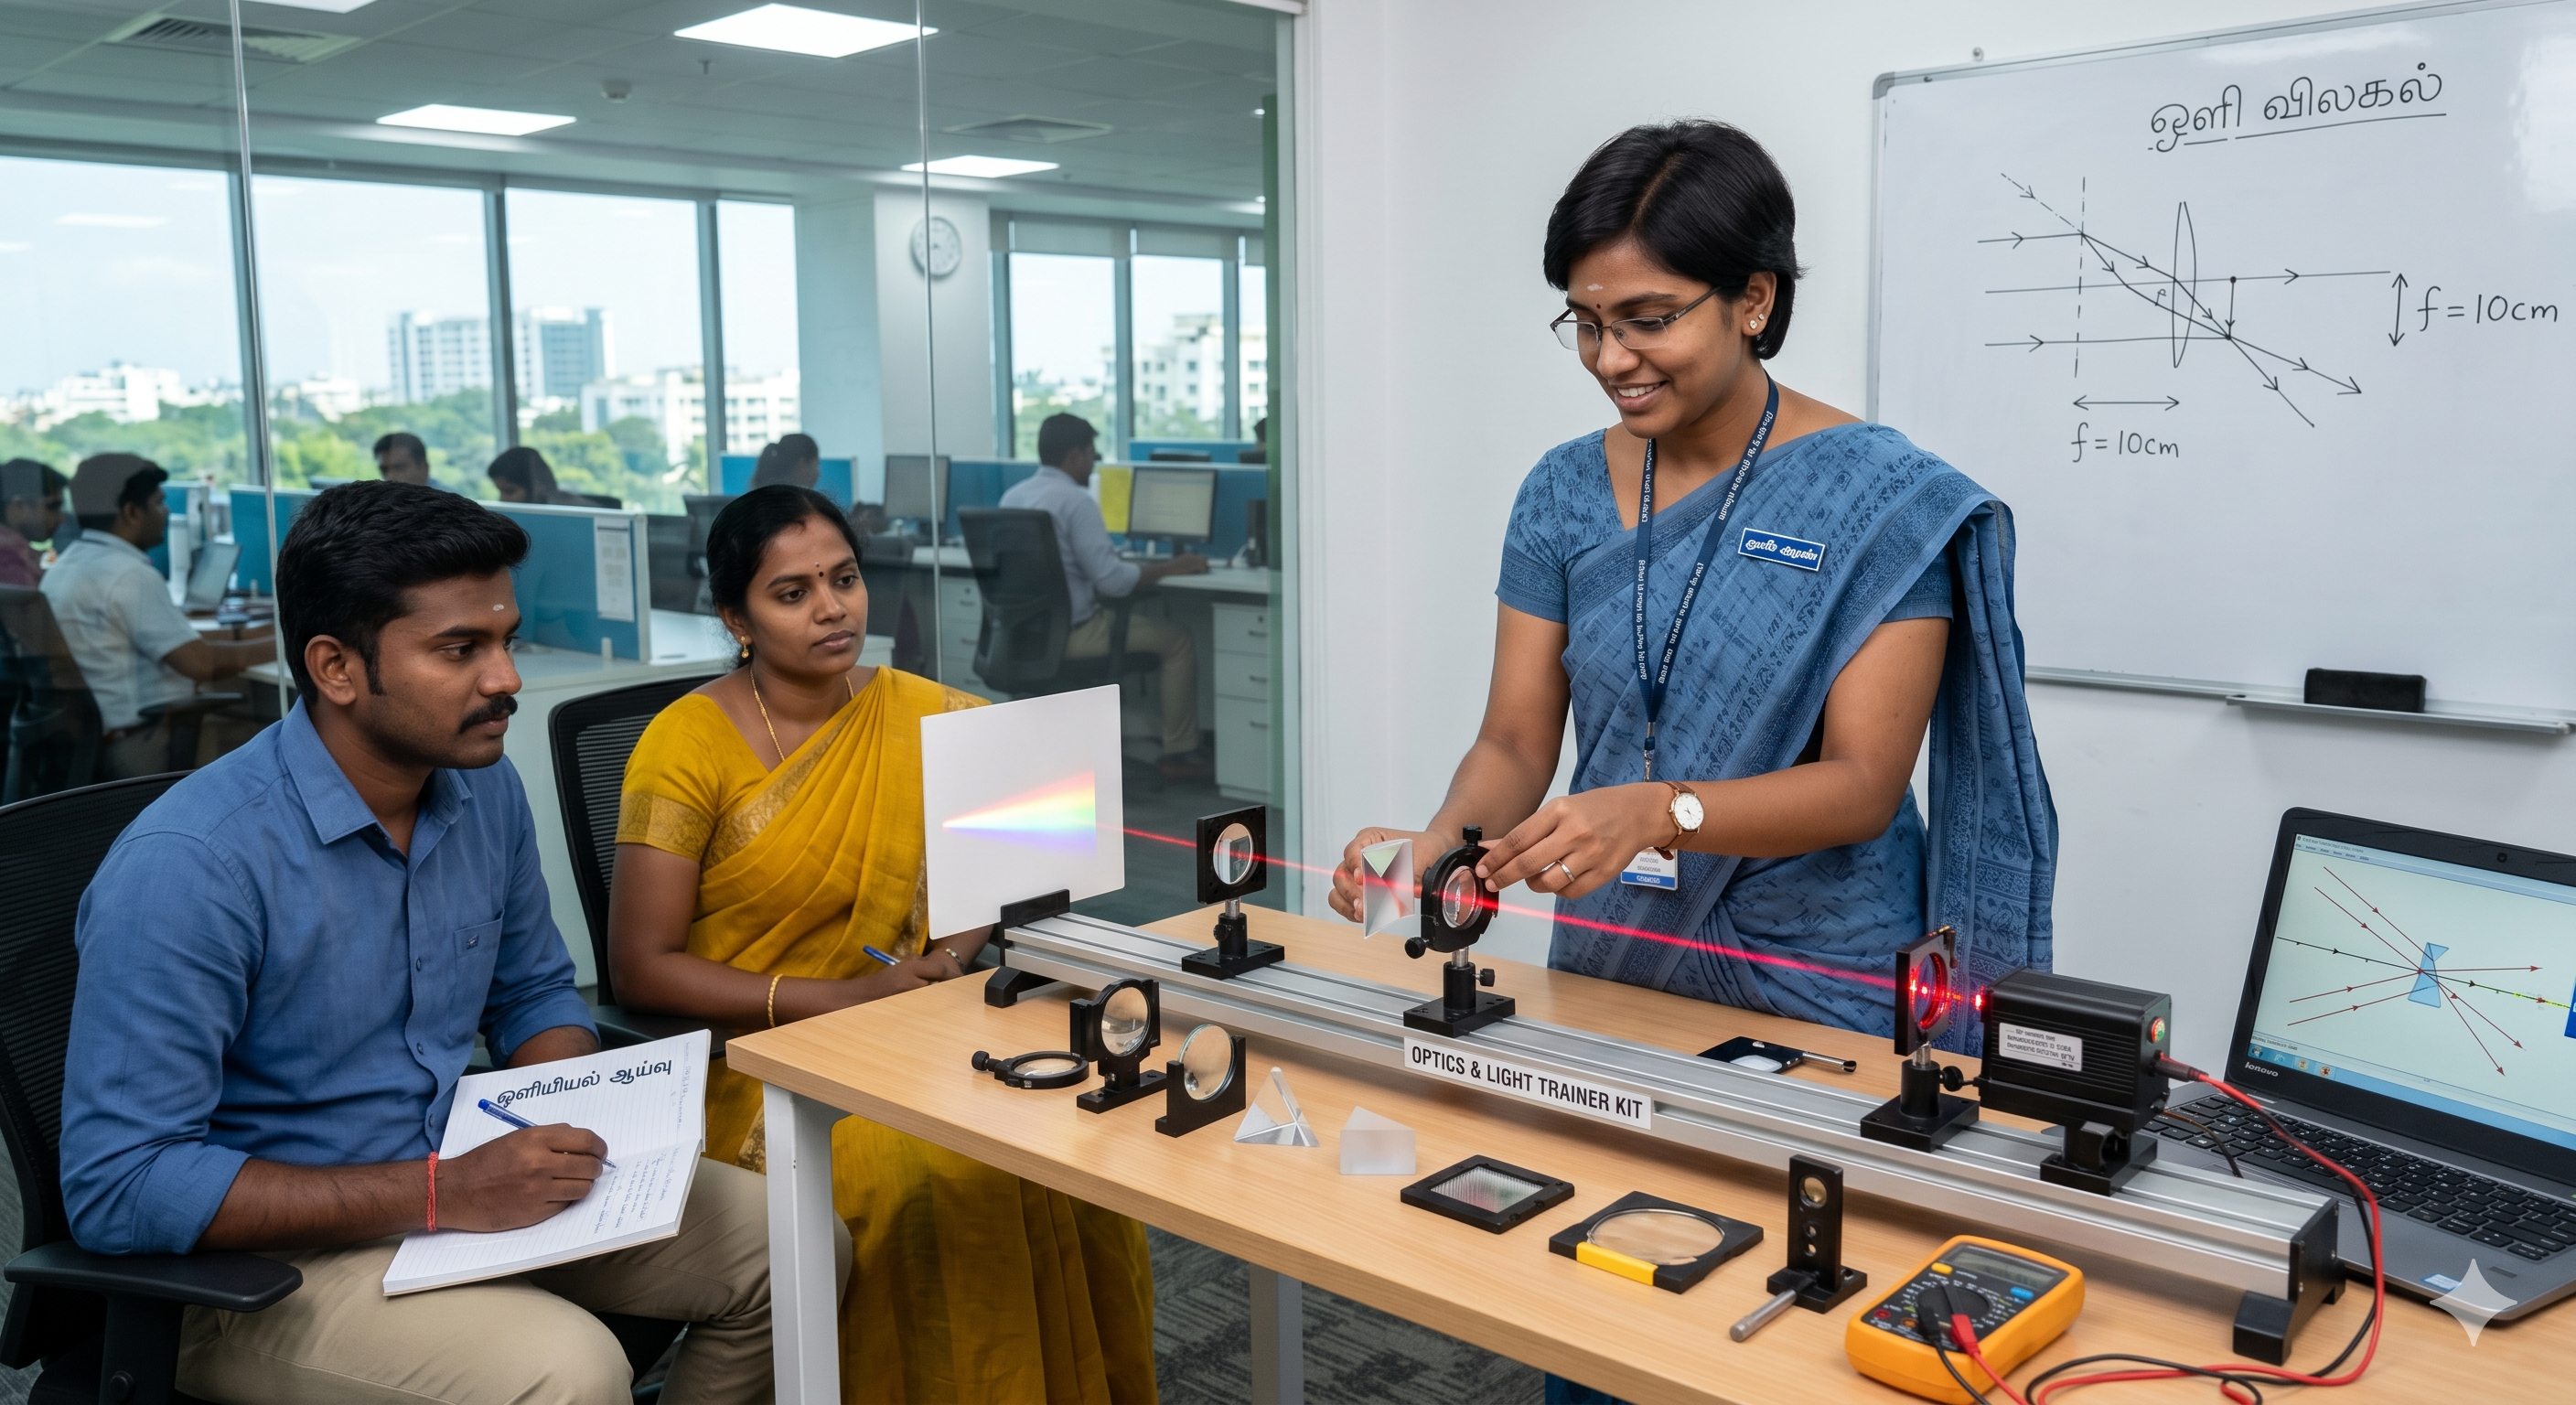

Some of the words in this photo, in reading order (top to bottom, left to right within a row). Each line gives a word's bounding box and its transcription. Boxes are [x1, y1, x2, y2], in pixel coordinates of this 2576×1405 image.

[2150, 83, 2242, 153] ஒளி
[2263, 61, 2443, 122] விலகல்
[497, 1070, 601, 1109] ஒளியியல்
[609, 1059, 673, 1085] ஆய்வு
[1411, 1046, 1465, 1075] OPTICS
[1470, 1060, 1481, 1079] &
[1487, 1064, 1533, 1092] LIGHT
[1538, 1077, 1610, 1112] TRAINER
[1615, 1096, 1644, 1120] KIT
